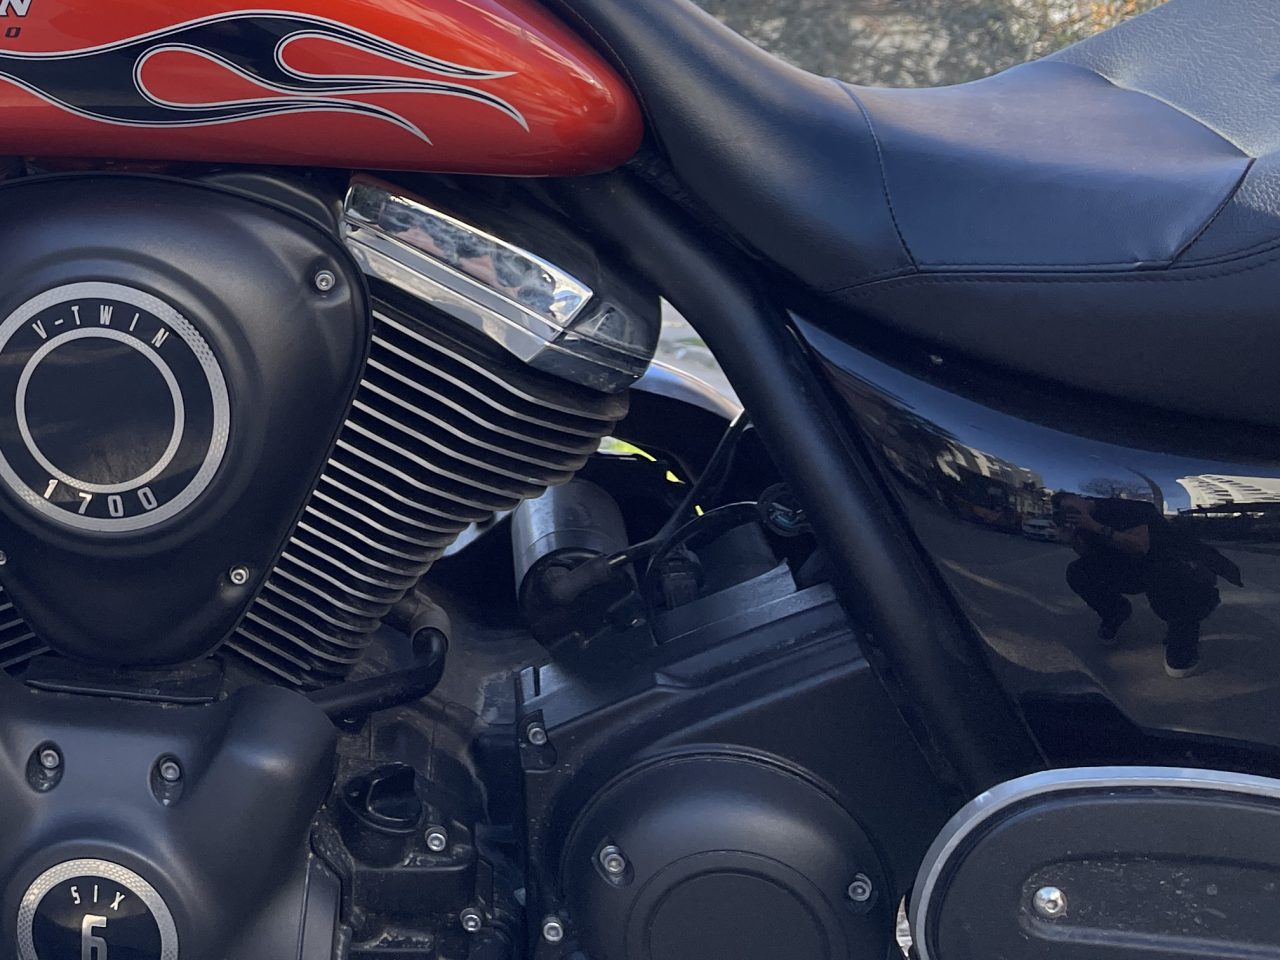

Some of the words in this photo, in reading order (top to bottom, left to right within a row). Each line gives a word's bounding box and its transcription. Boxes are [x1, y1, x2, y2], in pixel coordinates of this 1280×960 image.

[32, 305, 169, 348] V-TWIN
[43, 479, 158, 517] 1700
[71, 884, 126, 911] SIX
